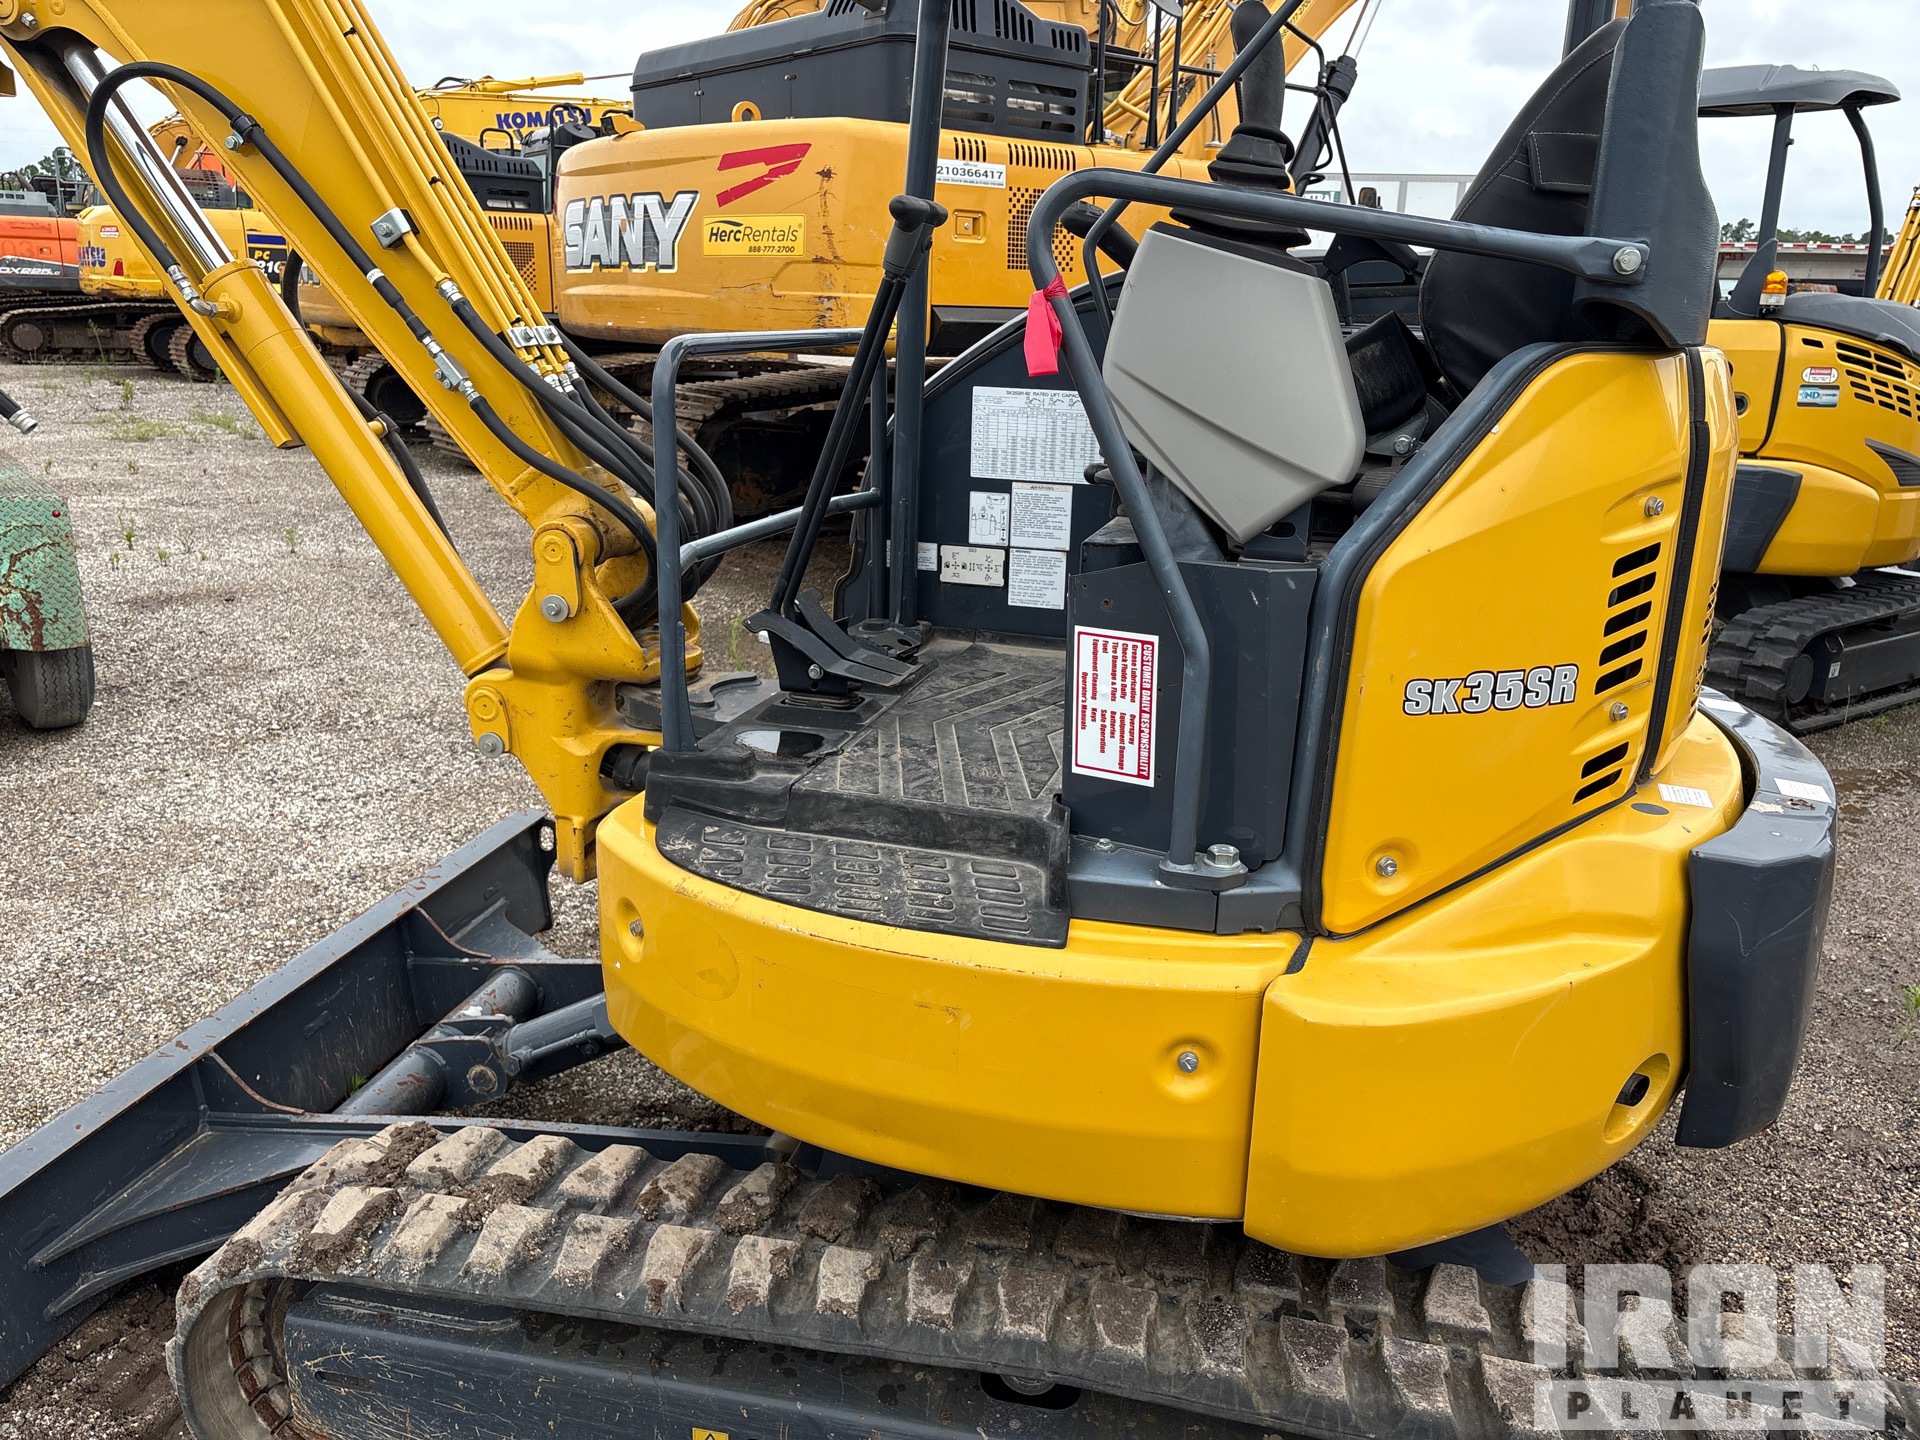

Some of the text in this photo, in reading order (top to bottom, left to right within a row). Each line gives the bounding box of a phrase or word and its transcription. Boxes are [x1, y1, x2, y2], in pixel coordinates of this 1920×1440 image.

[496, 109, 592, 129] KOMATSU
[254, 250, 270, 260] PC
[565, 190, 700, 272] SANY
[1140, 644, 1152, 776] CUSTOMER DAILY RESPONSIBILITY
[1403, 663, 1579, 715] SK35SR
